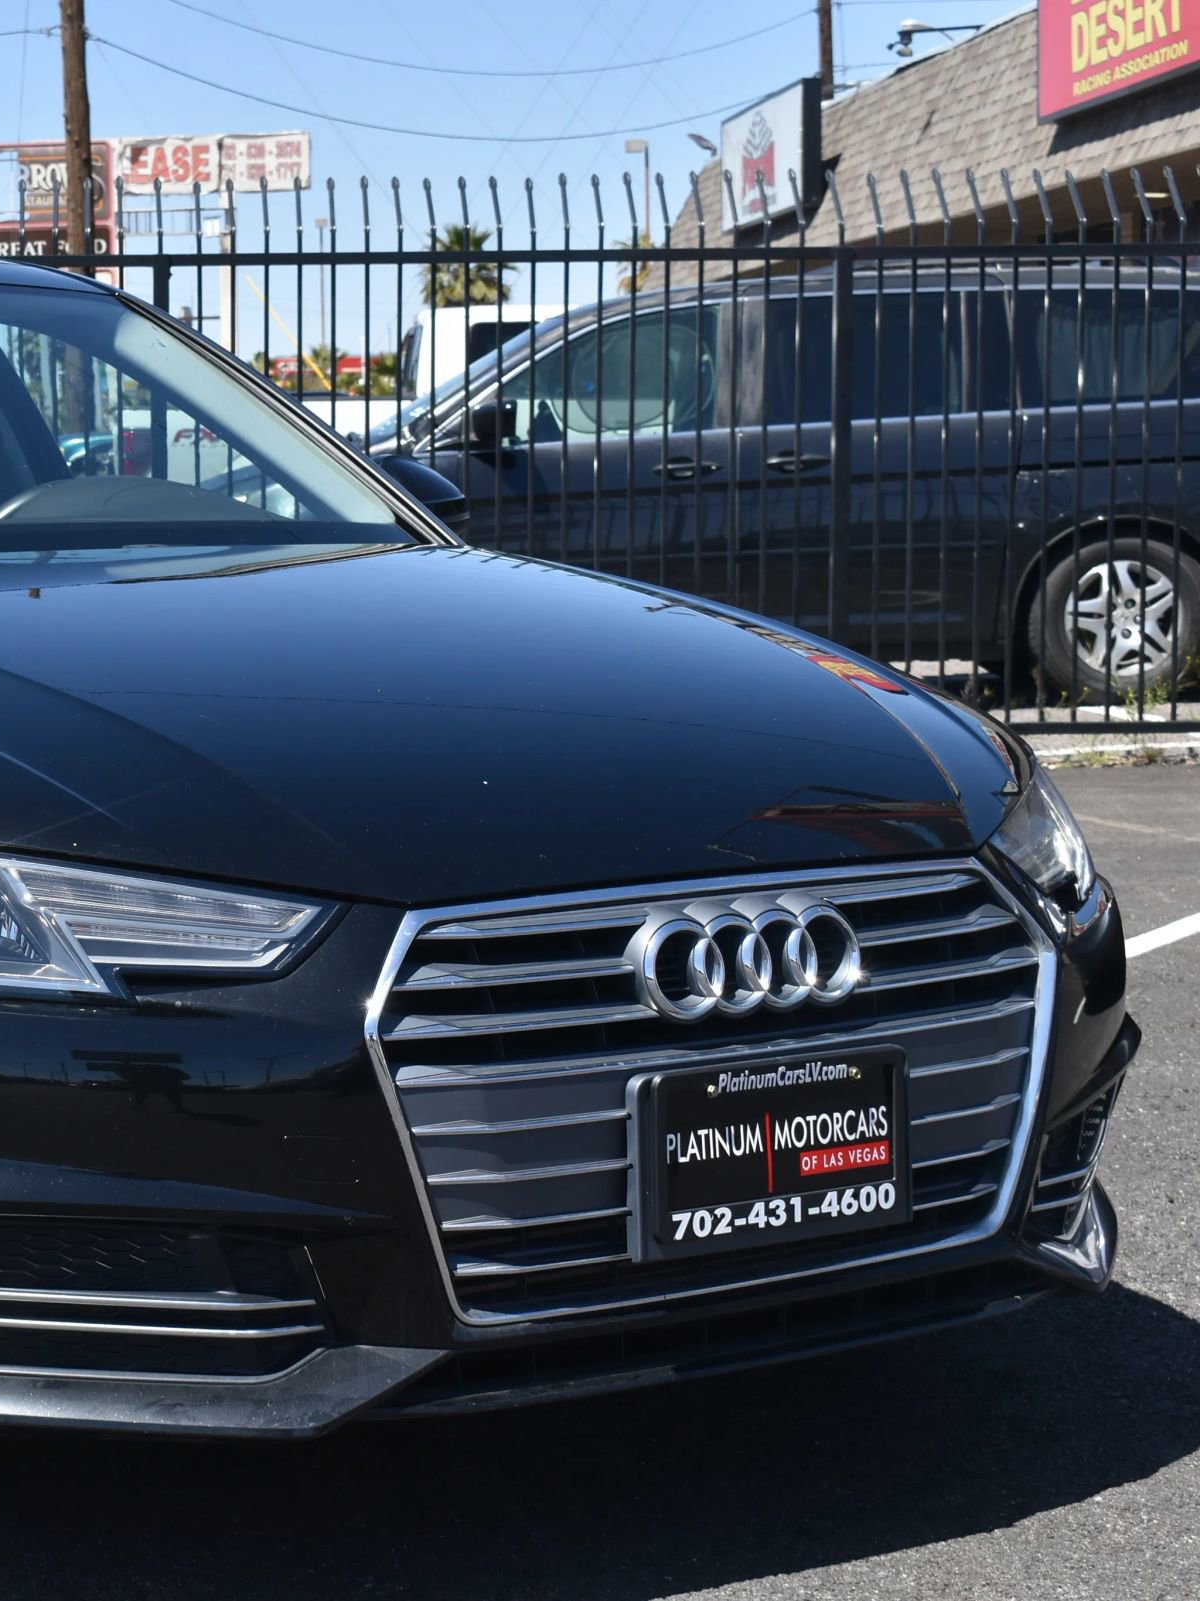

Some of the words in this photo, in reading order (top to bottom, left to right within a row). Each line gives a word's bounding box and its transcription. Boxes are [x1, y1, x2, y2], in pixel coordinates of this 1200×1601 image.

[1073, 70, 1112, 97] RACING
[1113, 39, 1189, 81] ASSOCIATION
[718, 1062, 848, 1093] PlatinumCarsLV.com
[666, 1122, 764, 1165] PLATINUM
[774, 1105, 888, 1151] MOTORCARS
[801, 1155, 818, 1171] OF
[823, 1151, 843, 1168] LAS
[849, 1145, 886, 1163] VEGAS
[672, 1182, 896, 1241] 702-431-4600
